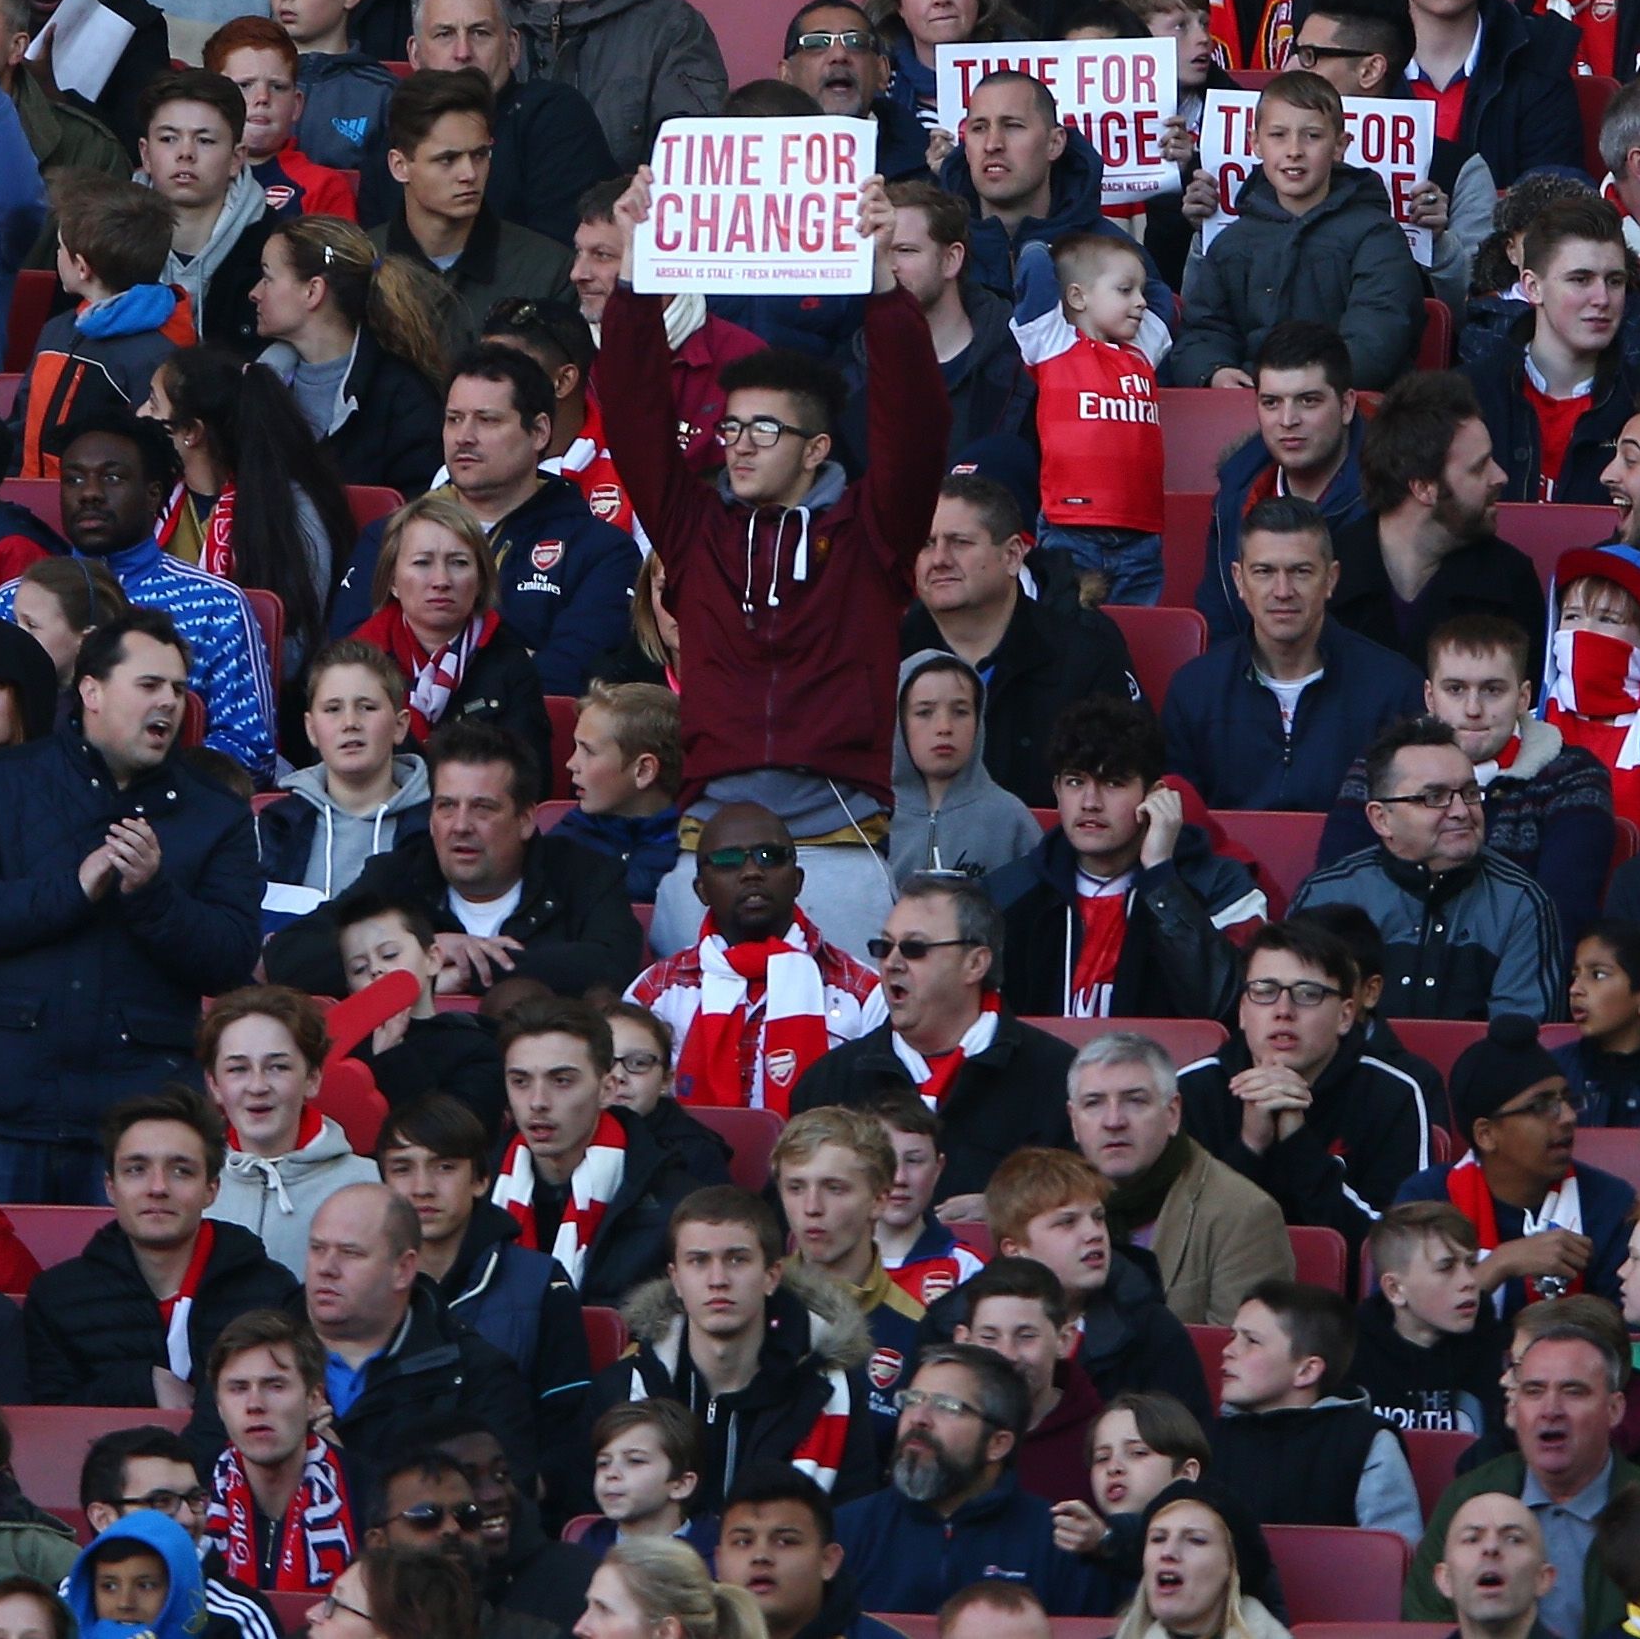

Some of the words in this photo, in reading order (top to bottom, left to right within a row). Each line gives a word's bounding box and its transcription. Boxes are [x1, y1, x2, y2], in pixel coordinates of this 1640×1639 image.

[1080, 57, 1156, 104] FOR
[665, 138, 761, 185] TIME
[784, 135, 856, 185] FOR
[658, 194, 855, 252] CHANGE
[1078, 391, 1161, 426] Emira
[1120, 374, 1152, 398] Fly
